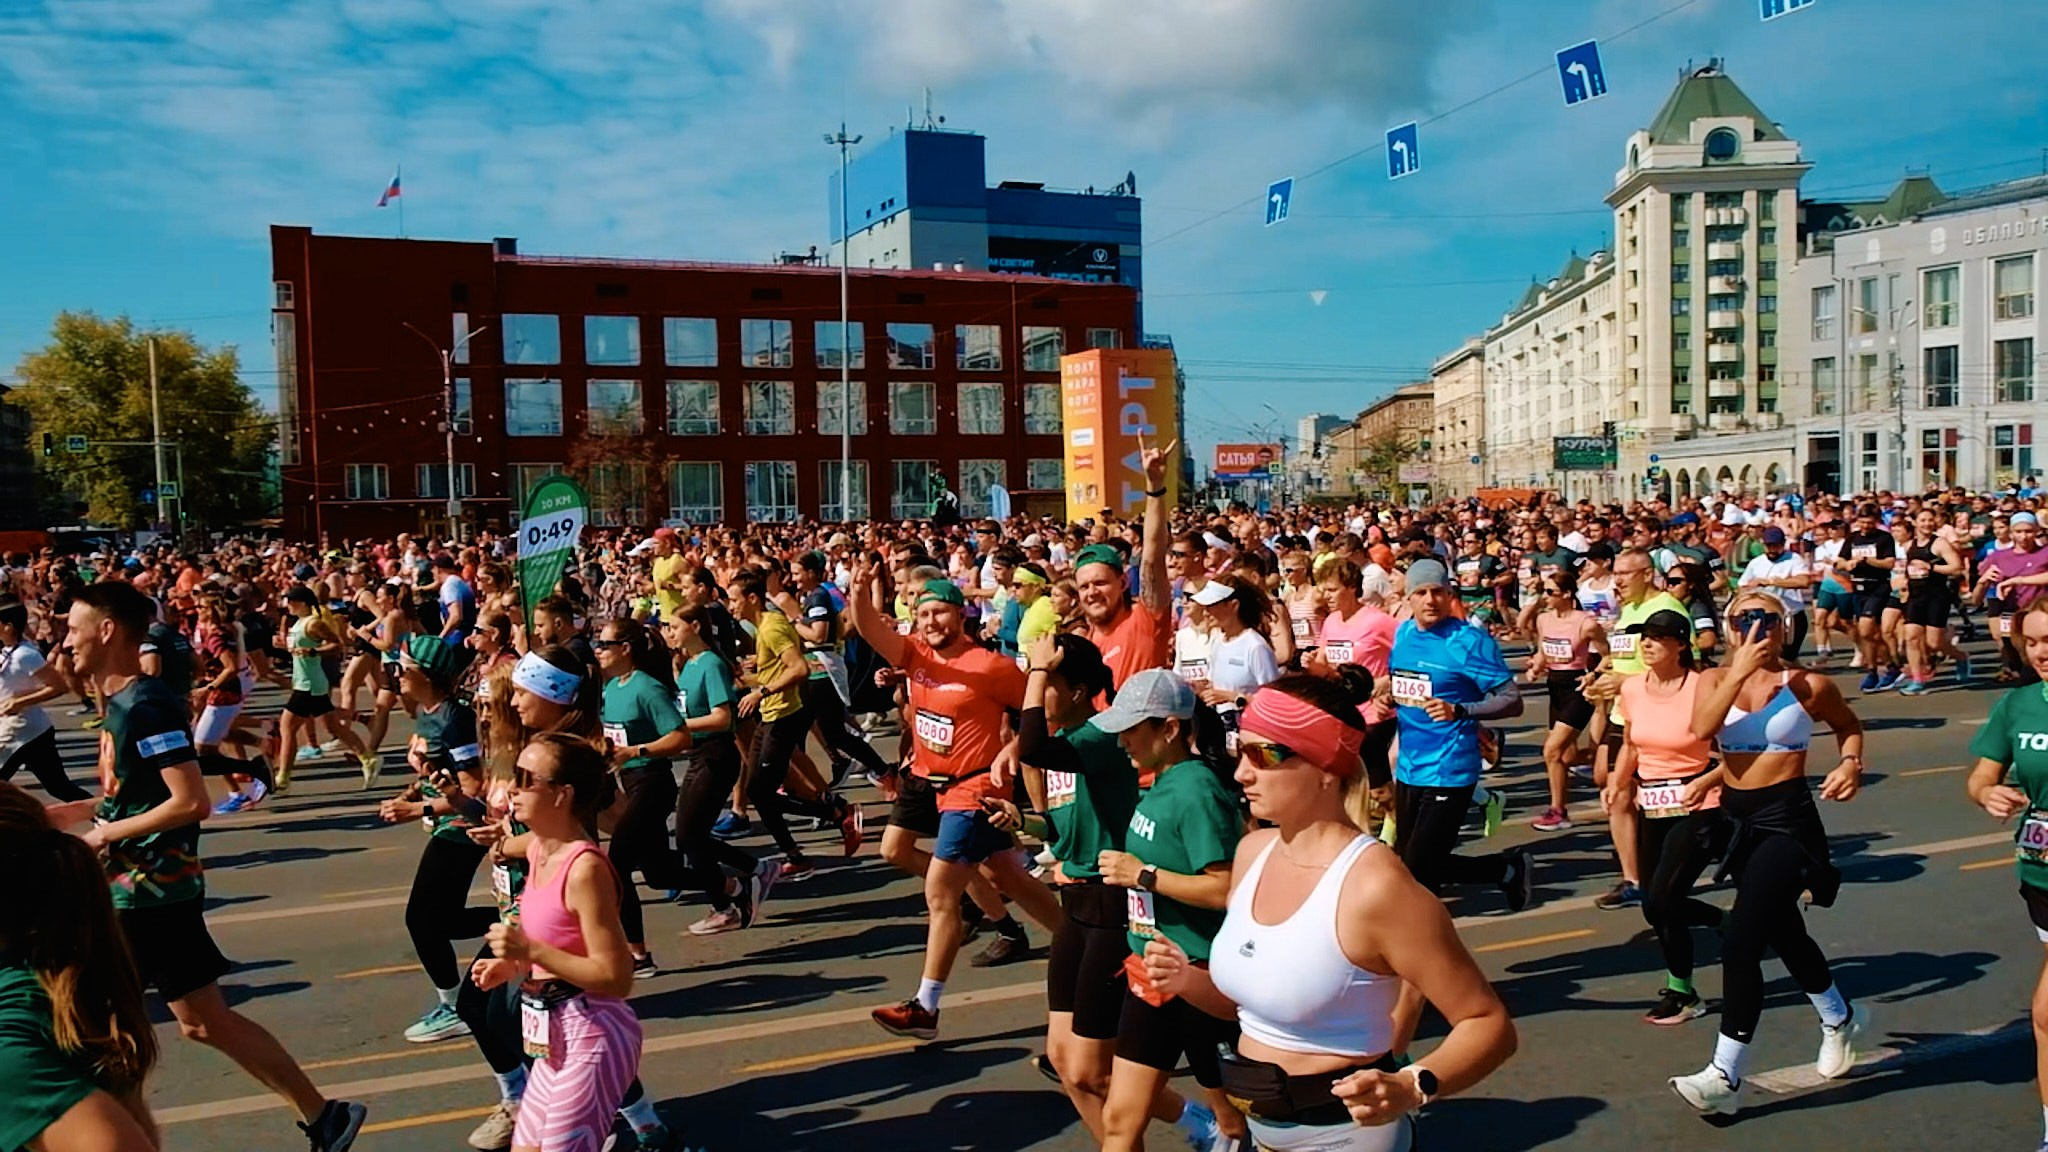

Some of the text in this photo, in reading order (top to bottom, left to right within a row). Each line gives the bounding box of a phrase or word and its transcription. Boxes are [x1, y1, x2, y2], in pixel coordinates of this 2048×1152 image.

[1218, 452, 1255, 466] САТЬЯ
[528, 518, 574, 546] 0:49
[1395, 680, 1426, 697] 2169
[918, 719, 948, 742] 2080
